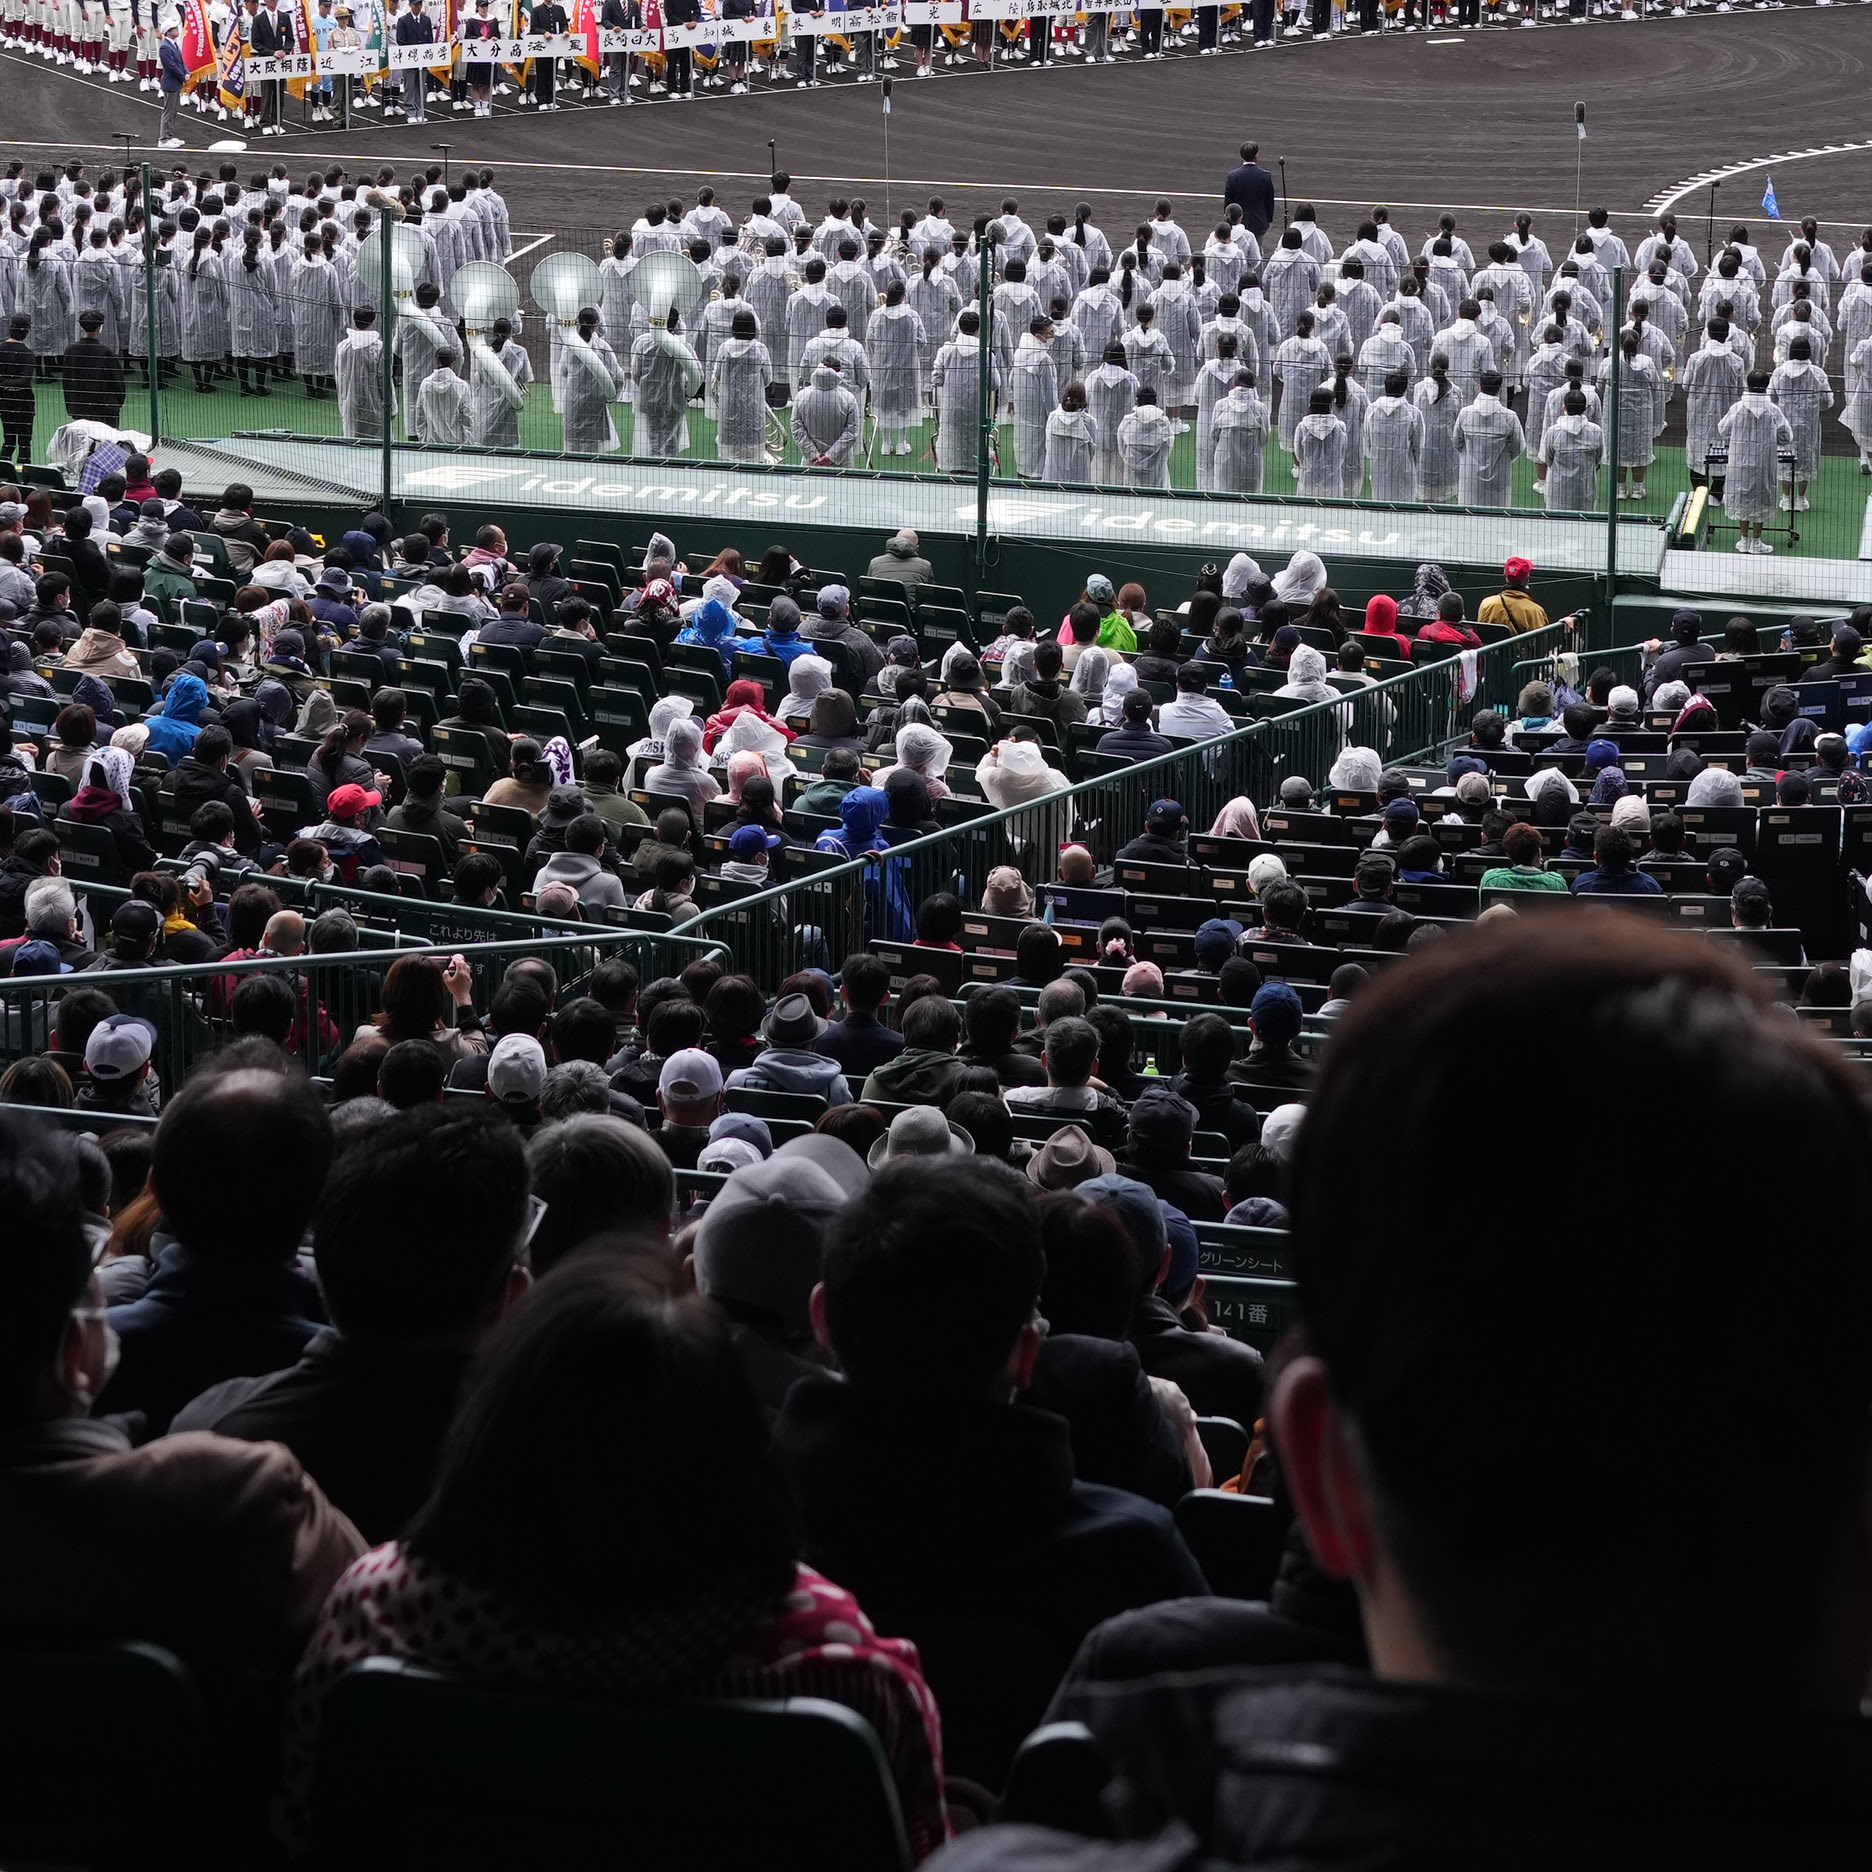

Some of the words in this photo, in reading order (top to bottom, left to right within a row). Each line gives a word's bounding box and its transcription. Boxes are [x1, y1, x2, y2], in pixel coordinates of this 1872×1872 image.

[928, 6, 941, 20] 光
[791, 17, 842, 32] 英明
[602, 30, 657, 48] 長崎日大
[667, 28, 716, 45] 高知
[248, 56, 309, 75] 大阪桐蔭
[320, 55, 376, 71] 近江
[519, 469, 826, 512] idemitsu
[1081, 503, 1401, 548] idemitsu
[428, 922, 498, 942] これより先は
